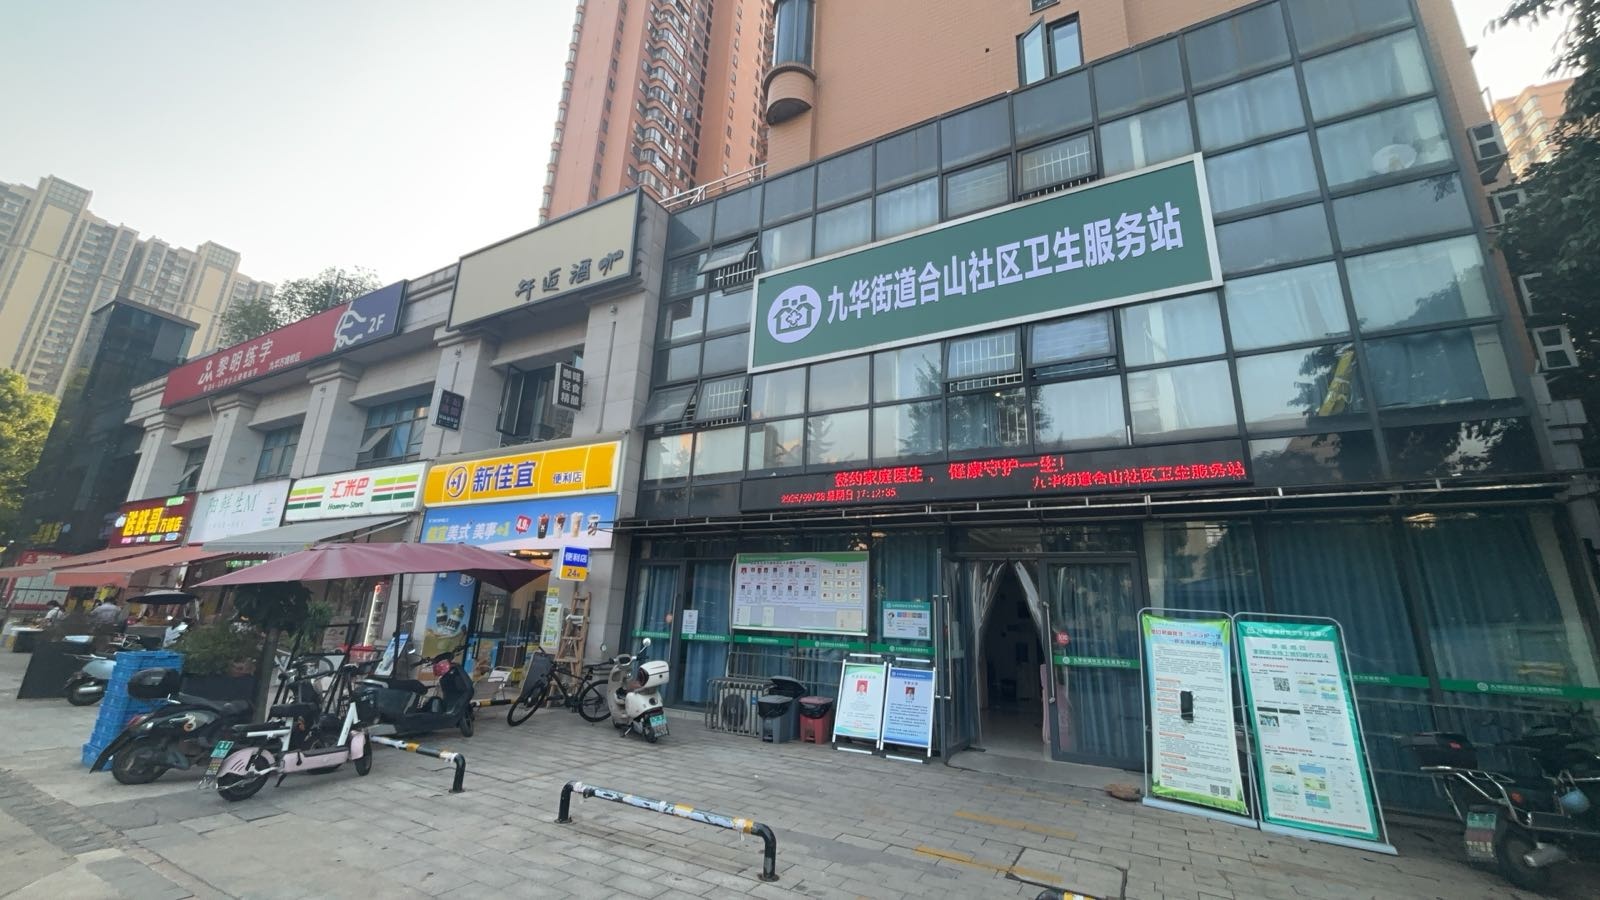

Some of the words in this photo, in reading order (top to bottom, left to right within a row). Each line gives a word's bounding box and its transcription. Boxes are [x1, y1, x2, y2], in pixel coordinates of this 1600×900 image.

[826, 201, 1184, 324] 九华街道合山社区卫生服务站
[367, 313, 386, 334] 2F
[216, 338, 274, 378] 黎明练字
[472, 461, 536, 492] 新佳宜
[552, 472, 583, 484] 便利店
[1033, 461, 1246, 488] 九华街道合山社区卫生服务站
[330, 477, 370, 499] 汇米巴
[565, 552, 588, 563] 便利店
